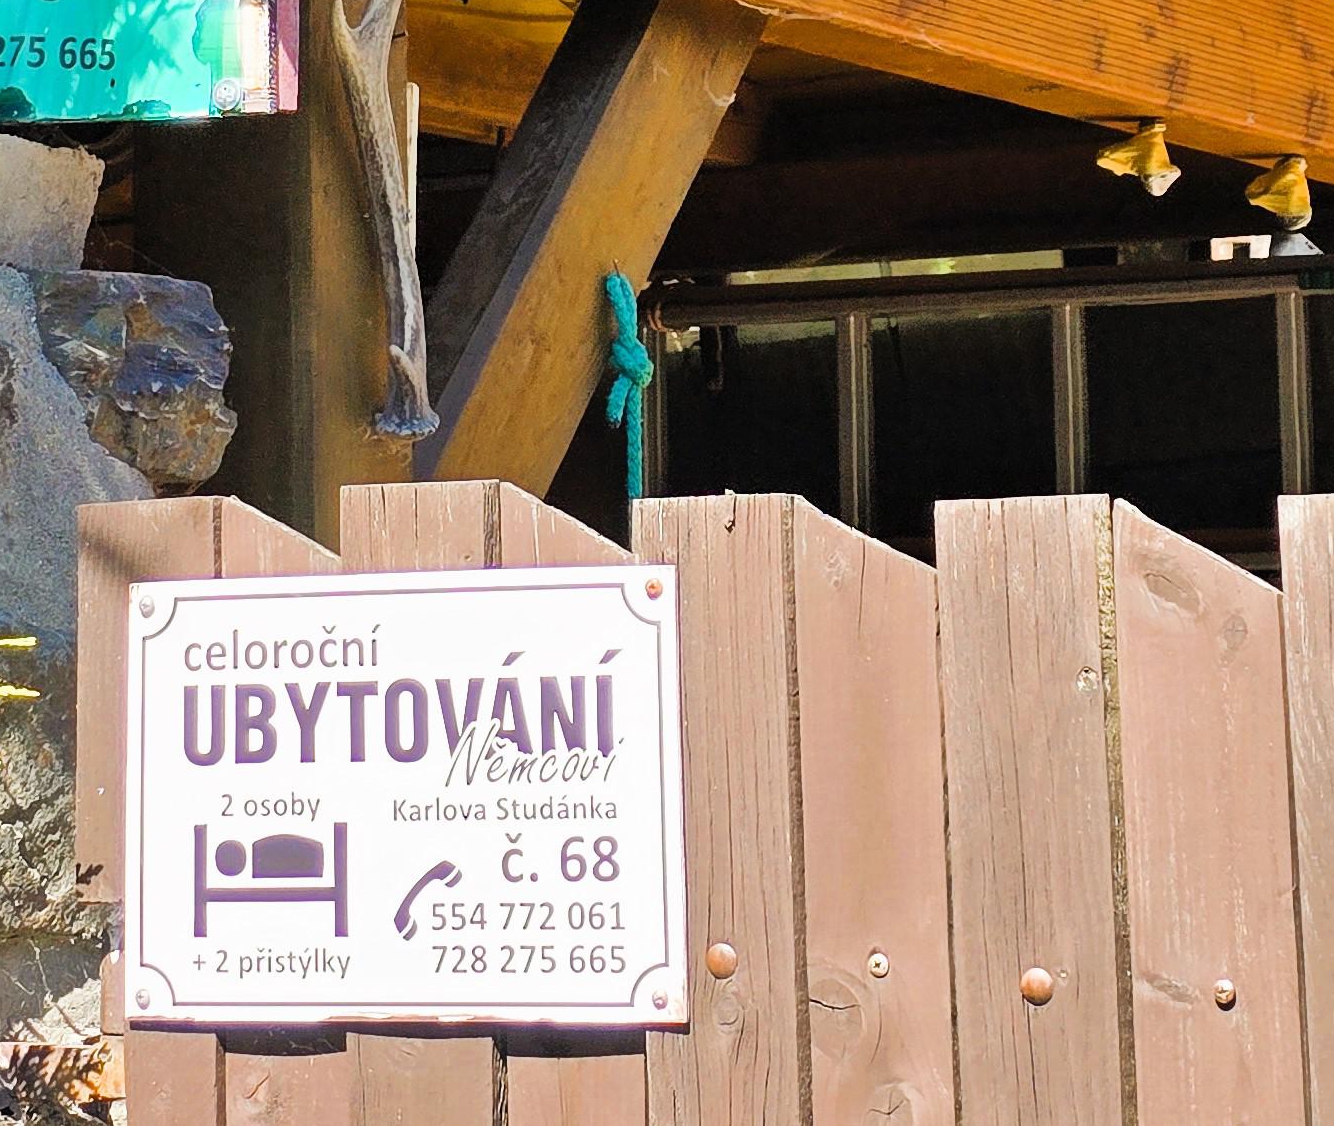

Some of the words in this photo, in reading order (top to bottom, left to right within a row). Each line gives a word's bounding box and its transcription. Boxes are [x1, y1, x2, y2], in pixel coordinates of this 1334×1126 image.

[59, 37, 116, 71] 665
[184, 624, 381, 671] celoroční
[183, 648, 624, 767] UBYTOVÁNÍ
[221, 793, 234, 817] 2
[243, 792, 322, 821] osoby
[393, 797, 487, 822] Karlova
[496, 794, 618, 821] Studánka
[501, 832, 539, 883] č.
[560, 835, 620, 883] 68
[431, 902, 488, 931] 554
[499, 901, 556, 931] 772
[567, 901, 626, 931] 061
[215, 949, 229, 973] 2
[239, 947, 351, 980] přistýlky
[431, 945, 488, 974] 728
[500, 945, 557, 974] 275
[569, 945, 627, 974] 665
